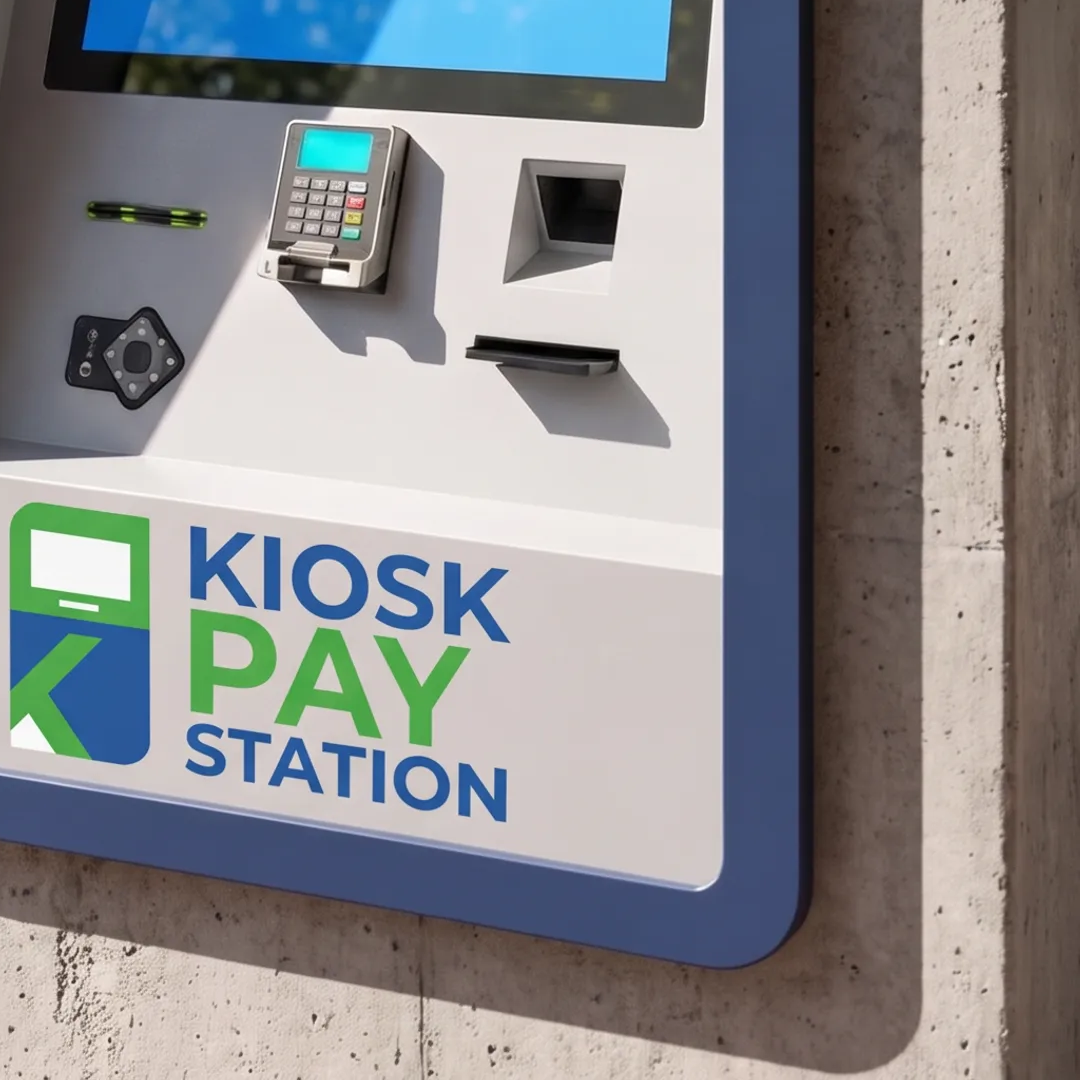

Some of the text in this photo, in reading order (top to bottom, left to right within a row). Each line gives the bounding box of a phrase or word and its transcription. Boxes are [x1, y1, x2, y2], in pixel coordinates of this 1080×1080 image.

[189, 525, 511, 644] KIOSK
[189, 608, 472, 748] PAY
[185, 722, 508, 823] STATION
